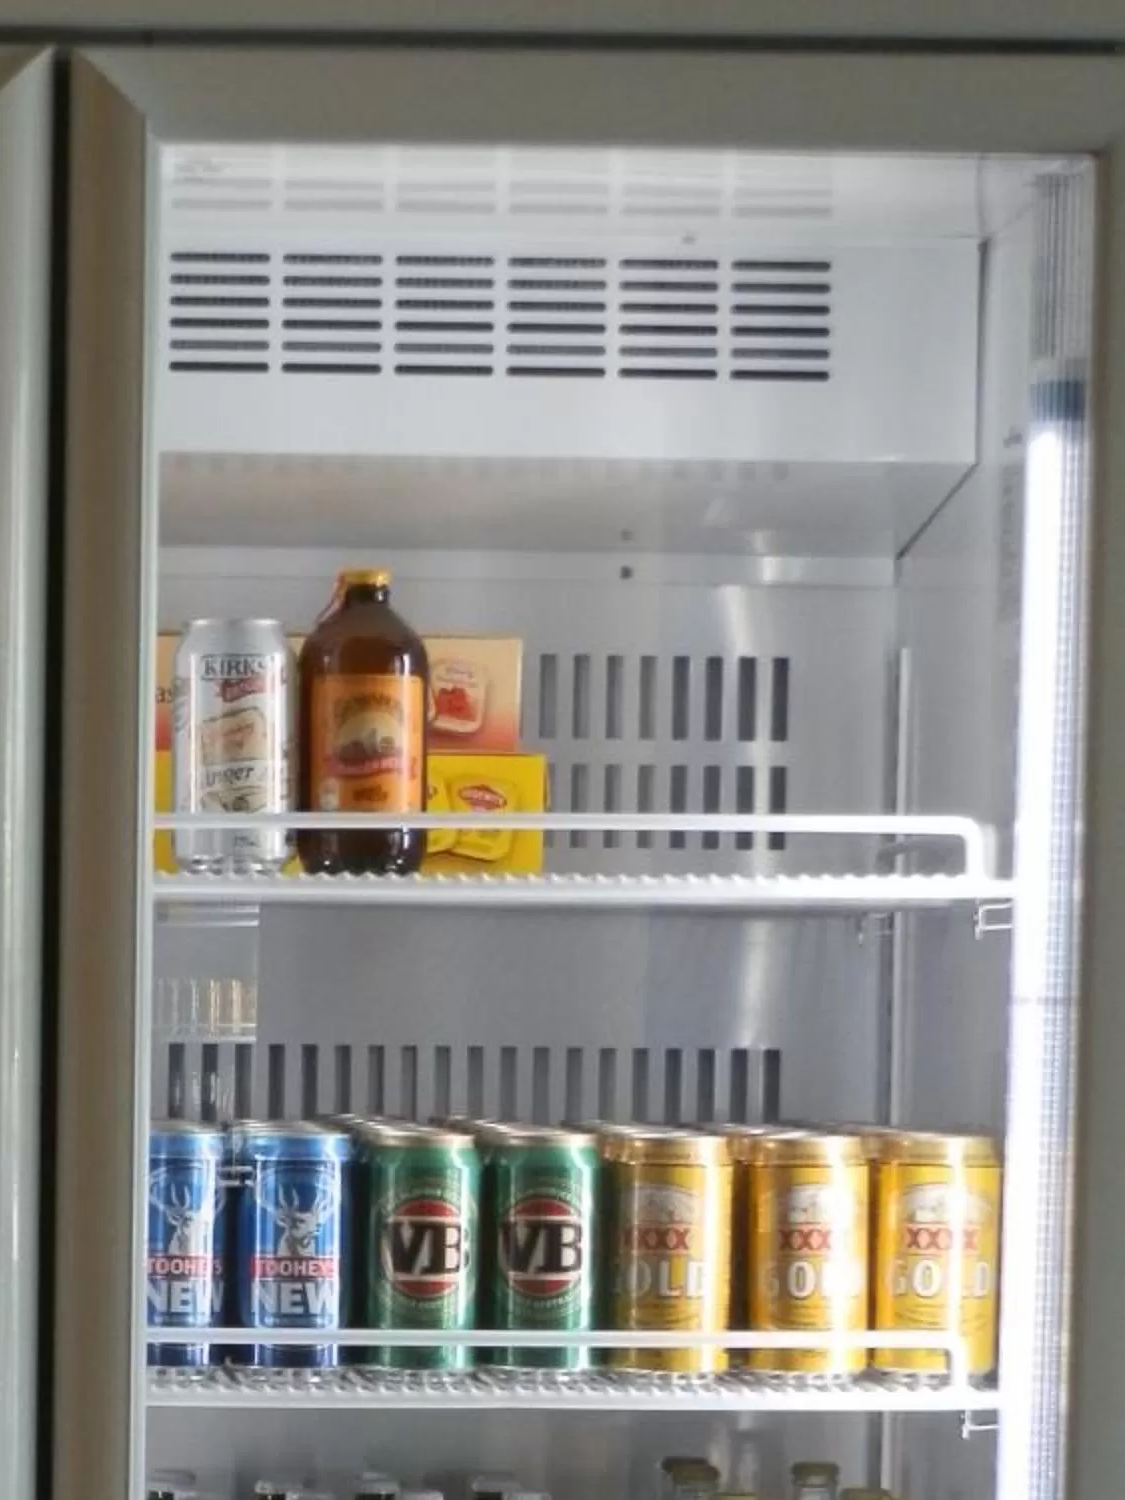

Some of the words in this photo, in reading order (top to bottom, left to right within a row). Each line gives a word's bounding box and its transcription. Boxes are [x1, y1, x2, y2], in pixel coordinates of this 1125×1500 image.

[505, 1220, 582, 1274] VB
[147, 1256, 222, 1275] TOOHES
[255, 1258, 336, 1277] TOOHEY
[147, 1279, 224, 1313] NEW
[251, 1281, 338, 1314] NEW
